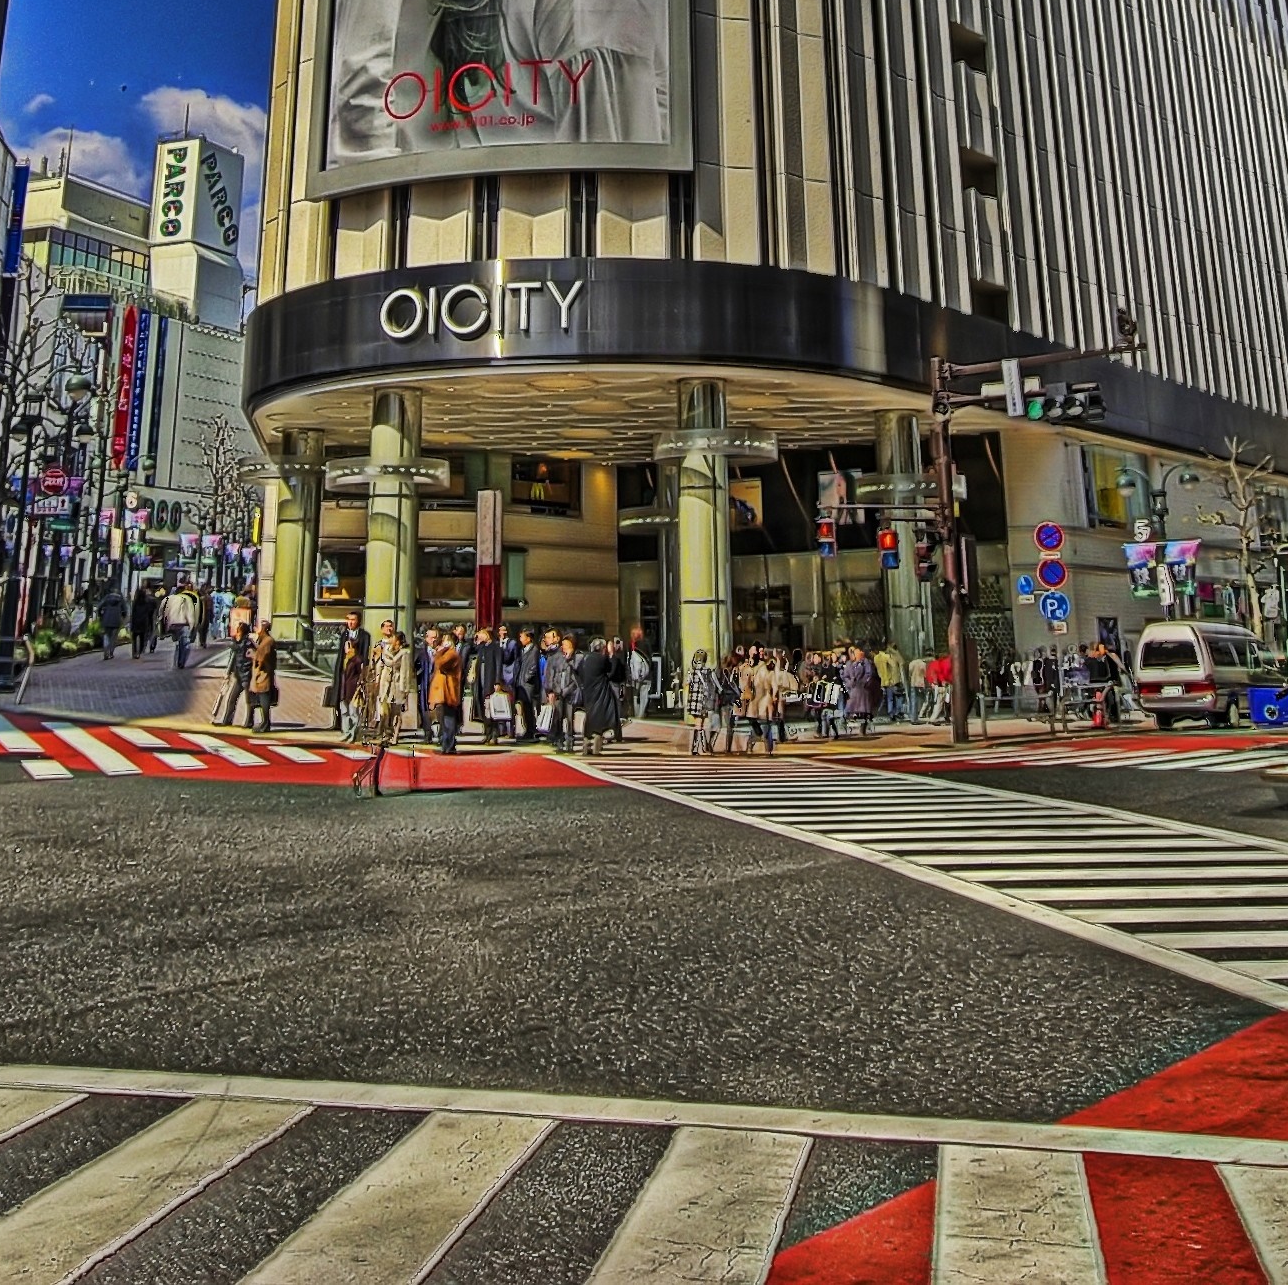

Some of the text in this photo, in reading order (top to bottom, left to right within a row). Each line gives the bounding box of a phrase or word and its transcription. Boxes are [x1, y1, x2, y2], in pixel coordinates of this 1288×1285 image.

[160, 146, 189, 237] PARCO
[201, 152, 240, 247] PARCO
[1045, 598, 1059, 616] P
